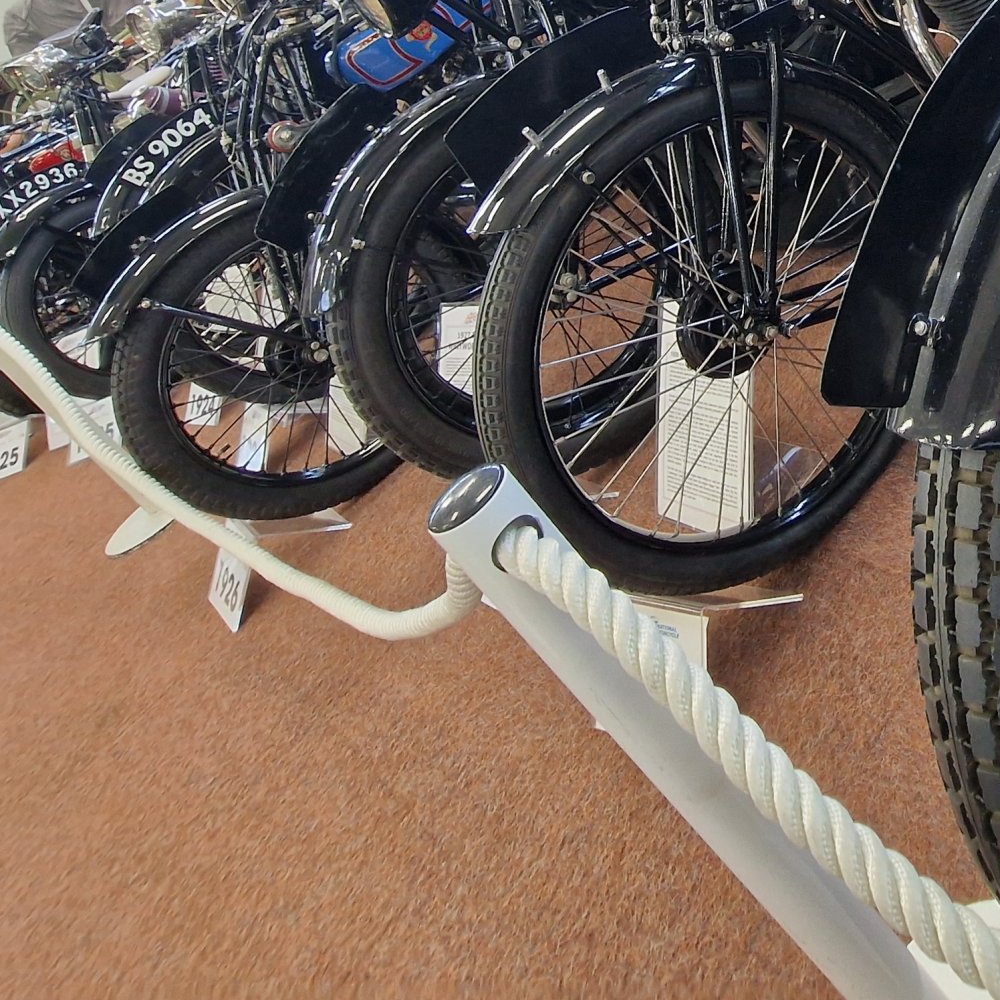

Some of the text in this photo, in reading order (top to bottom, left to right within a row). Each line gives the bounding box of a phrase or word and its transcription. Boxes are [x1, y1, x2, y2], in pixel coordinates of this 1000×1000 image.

[121, 107, 212, 187] BS 9064
[215, 560, 240, 612] 1926
